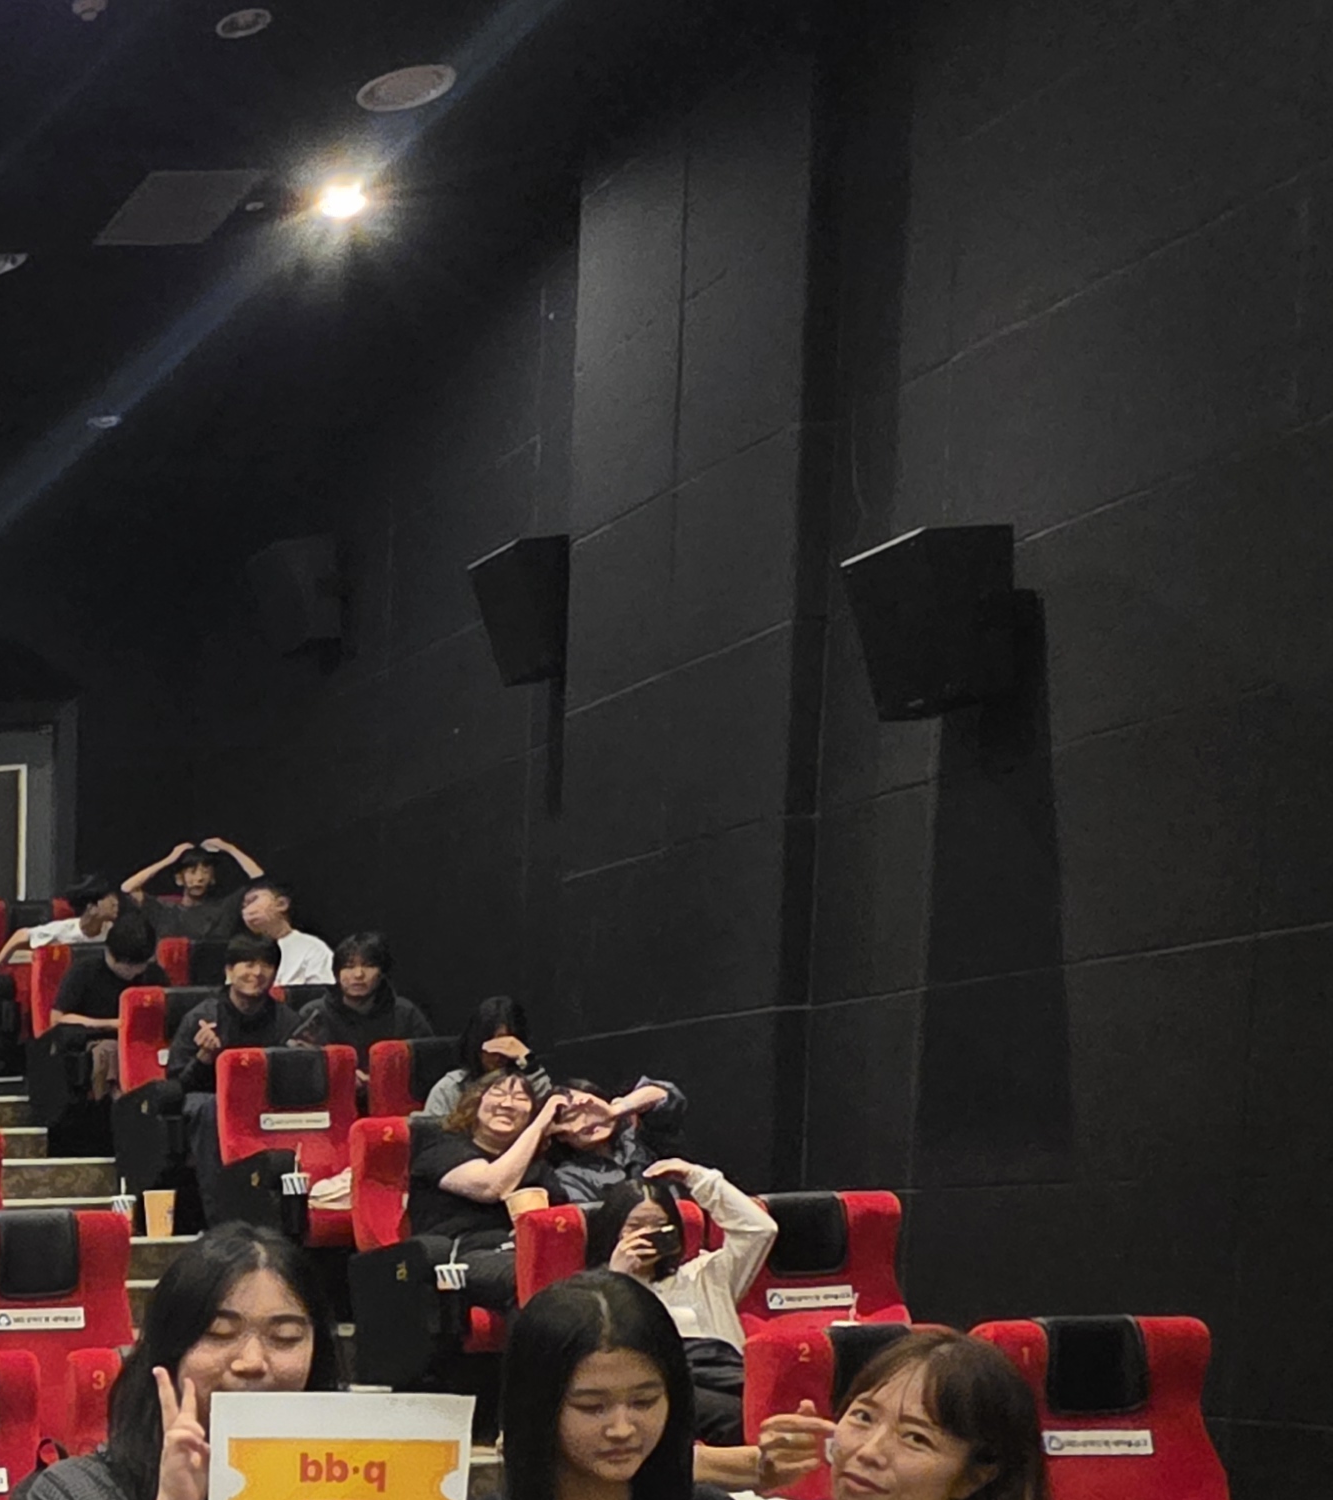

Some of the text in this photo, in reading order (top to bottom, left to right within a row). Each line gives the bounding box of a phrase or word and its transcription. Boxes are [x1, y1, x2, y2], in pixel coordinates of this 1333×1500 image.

[383, 1126, 394, 1142] 2
[555, 1216, 567, 1233] 2
[799, 1343, 812, 1363] 2
[92, 1370, 105, 1390] 3
